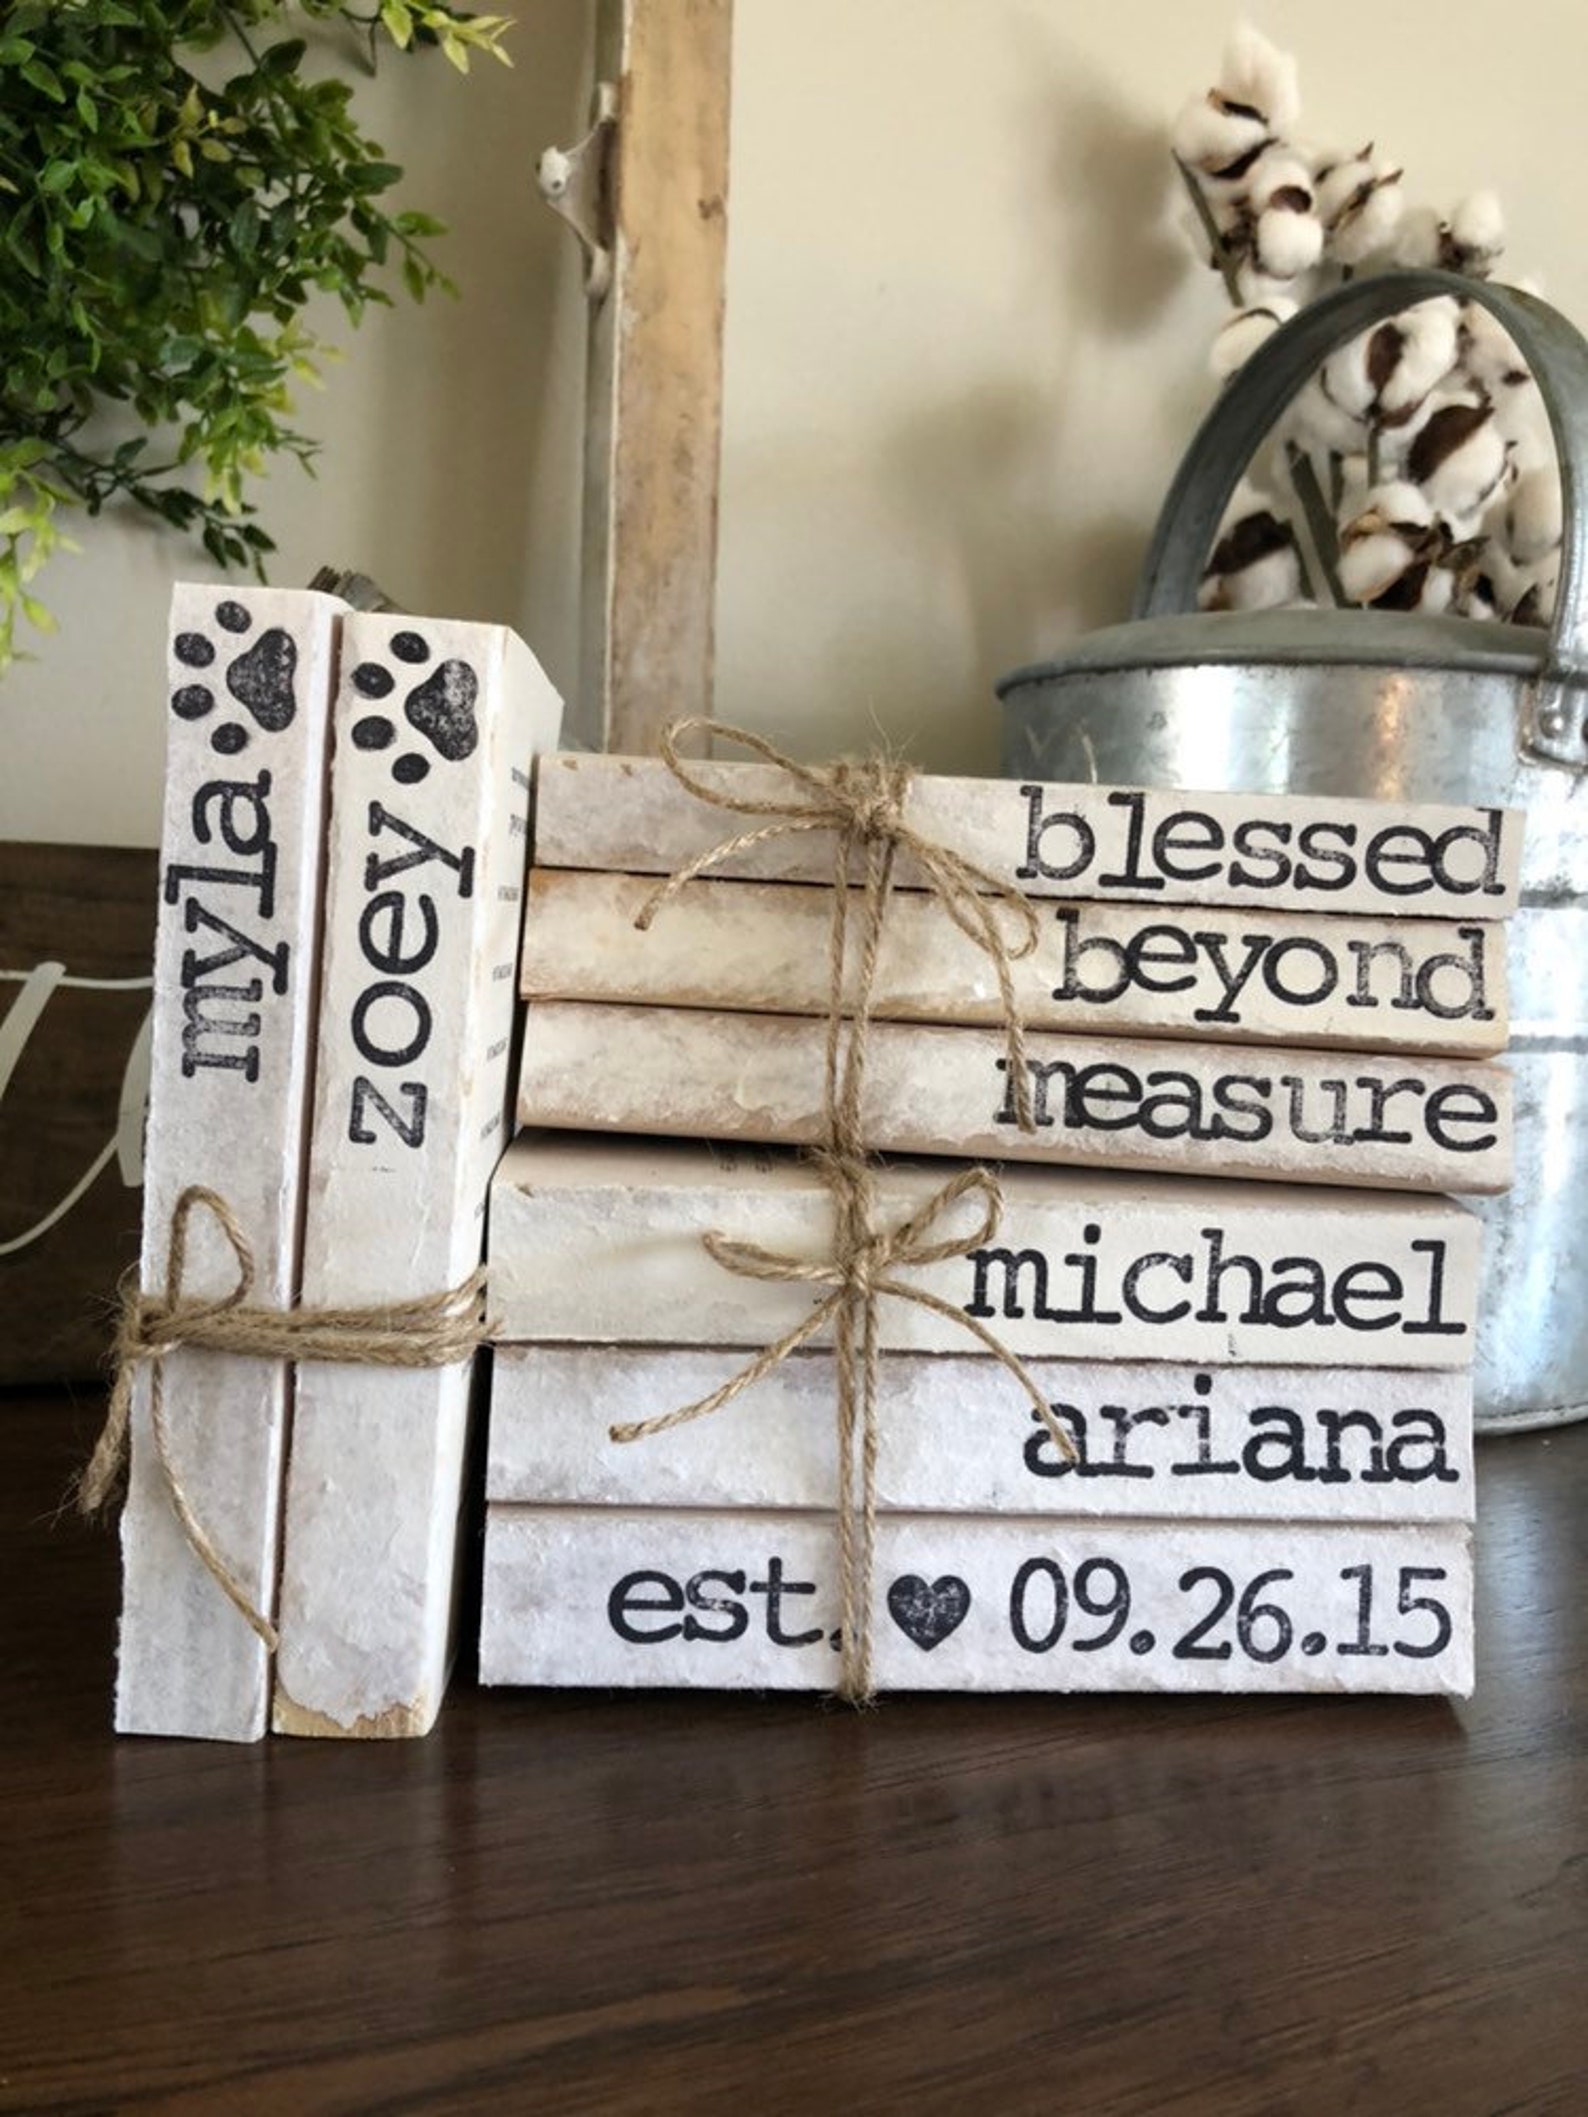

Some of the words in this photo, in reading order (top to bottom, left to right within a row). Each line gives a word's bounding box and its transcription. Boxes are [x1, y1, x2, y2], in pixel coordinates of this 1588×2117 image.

[1016, 785, 1506, 895] blessed
[164, 769, 290, 1083] myla
[348, 801, 475, 1149] zoey
[1052, 907, 1495, 1022] beyond
[993, 1058, 1498, 1152] measure
[963, 1224, 1467, 1335] michael
[1023, 1373, 1458, 1483] ariana
[1008, 1557, 1453, 1663] 09.26.15
